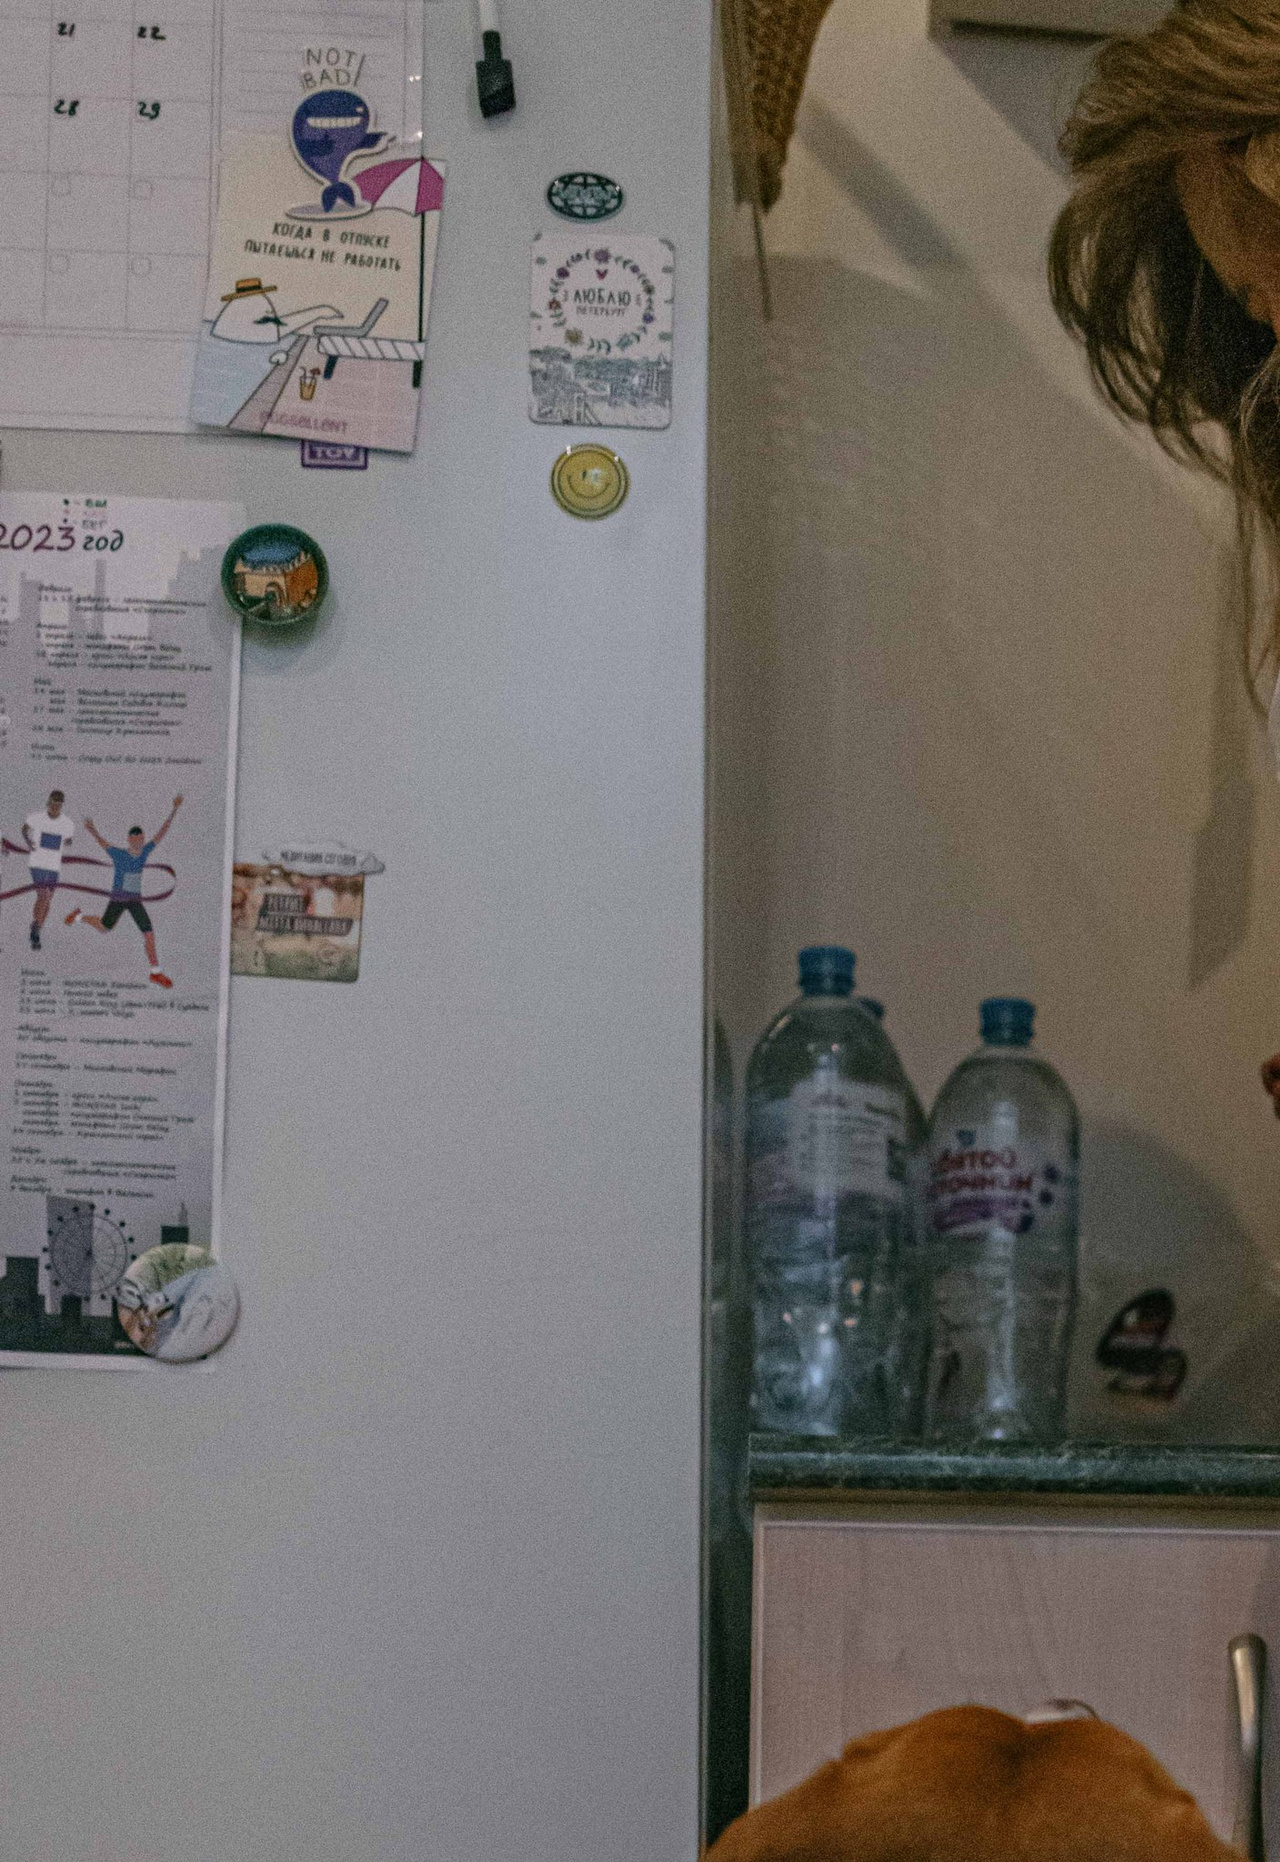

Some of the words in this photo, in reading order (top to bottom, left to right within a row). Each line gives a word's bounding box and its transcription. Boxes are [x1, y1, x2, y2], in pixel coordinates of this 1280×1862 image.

[57, 22, 76, 38] 21
[306, 47, 358, 68] NOT
[54, 99, 80, 117] 28
[138, 101, 161, 120] 29
[272, 222, 313, 242] КОГДА
[322, 229, 331, 242] В
[340, 231, 391, 250] ОТПУСКЕ
[244, 239, 316, 262] ПЫТАЕШЬСЯ
[321, 250, 336, 264] НЕ
[344, 252, 402, 273] РАБОТАТЬ
[573, 287, 632, 307] ЛЮБЛЮ
[82, 528, 125, 552] год
